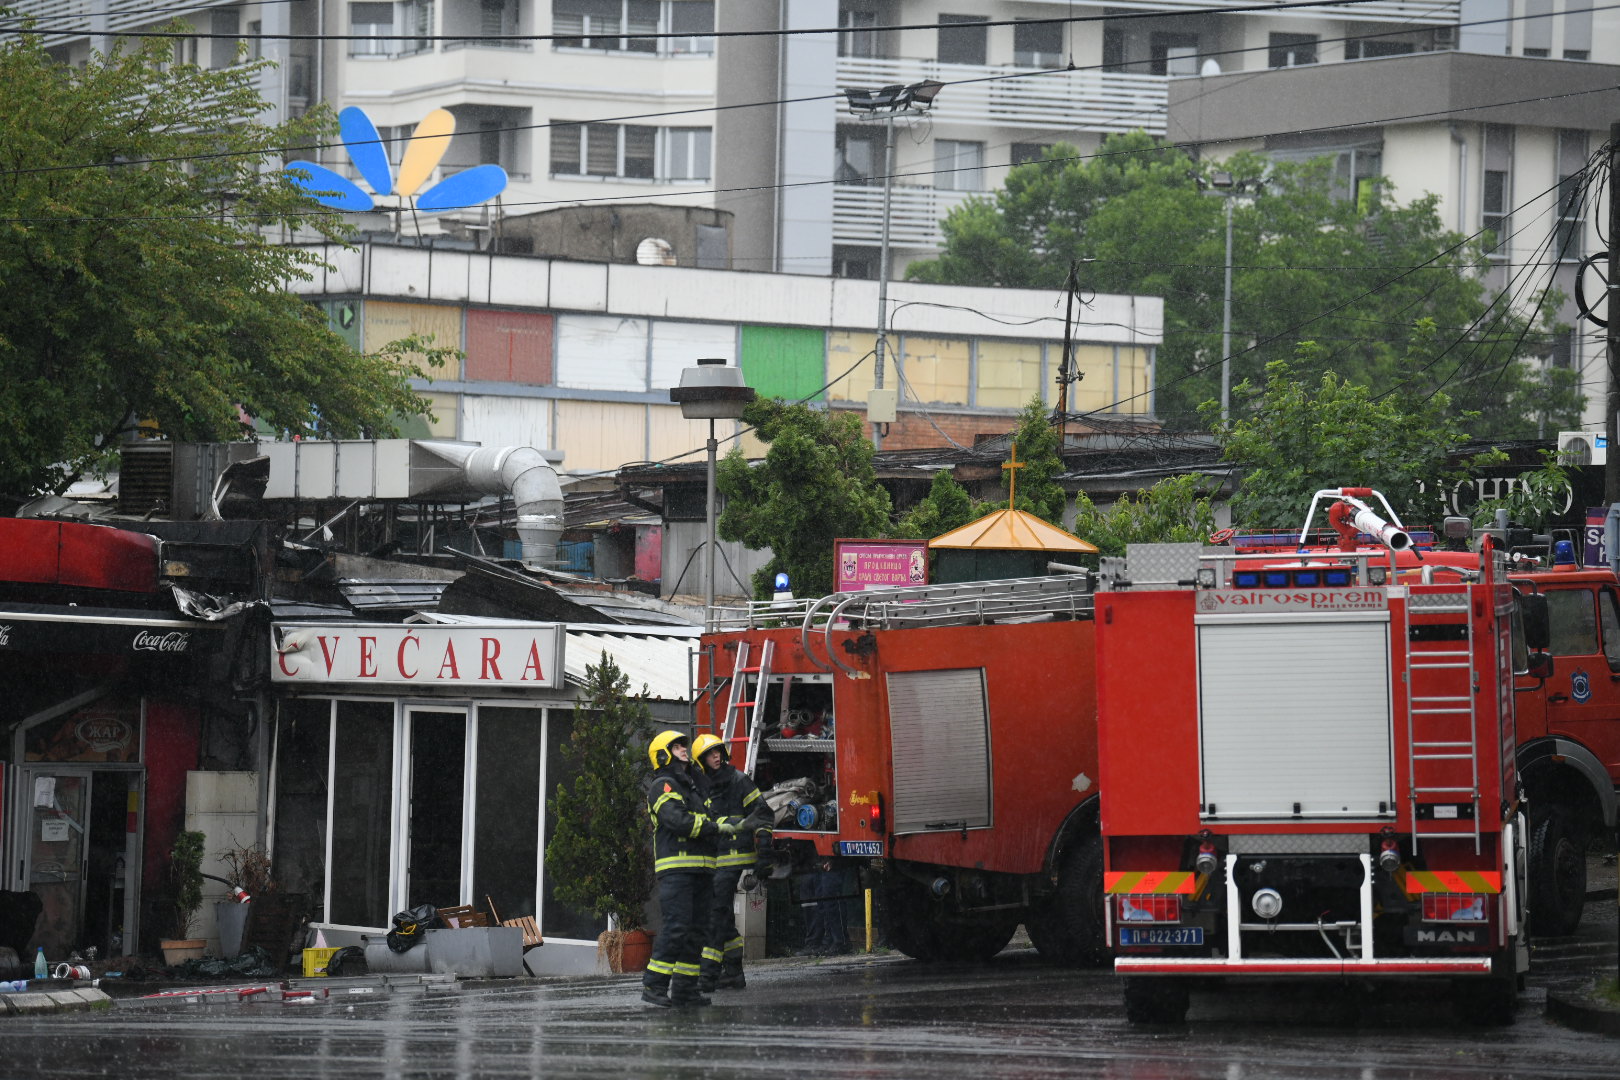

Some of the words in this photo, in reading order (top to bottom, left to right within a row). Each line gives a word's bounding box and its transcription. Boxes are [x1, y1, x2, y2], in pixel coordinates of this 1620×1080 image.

[1216, 591, 1382, 608] vatrosprem
[88, 726, 120, 737] ЖАР
[1417, 930, 1475, 942] MAN
